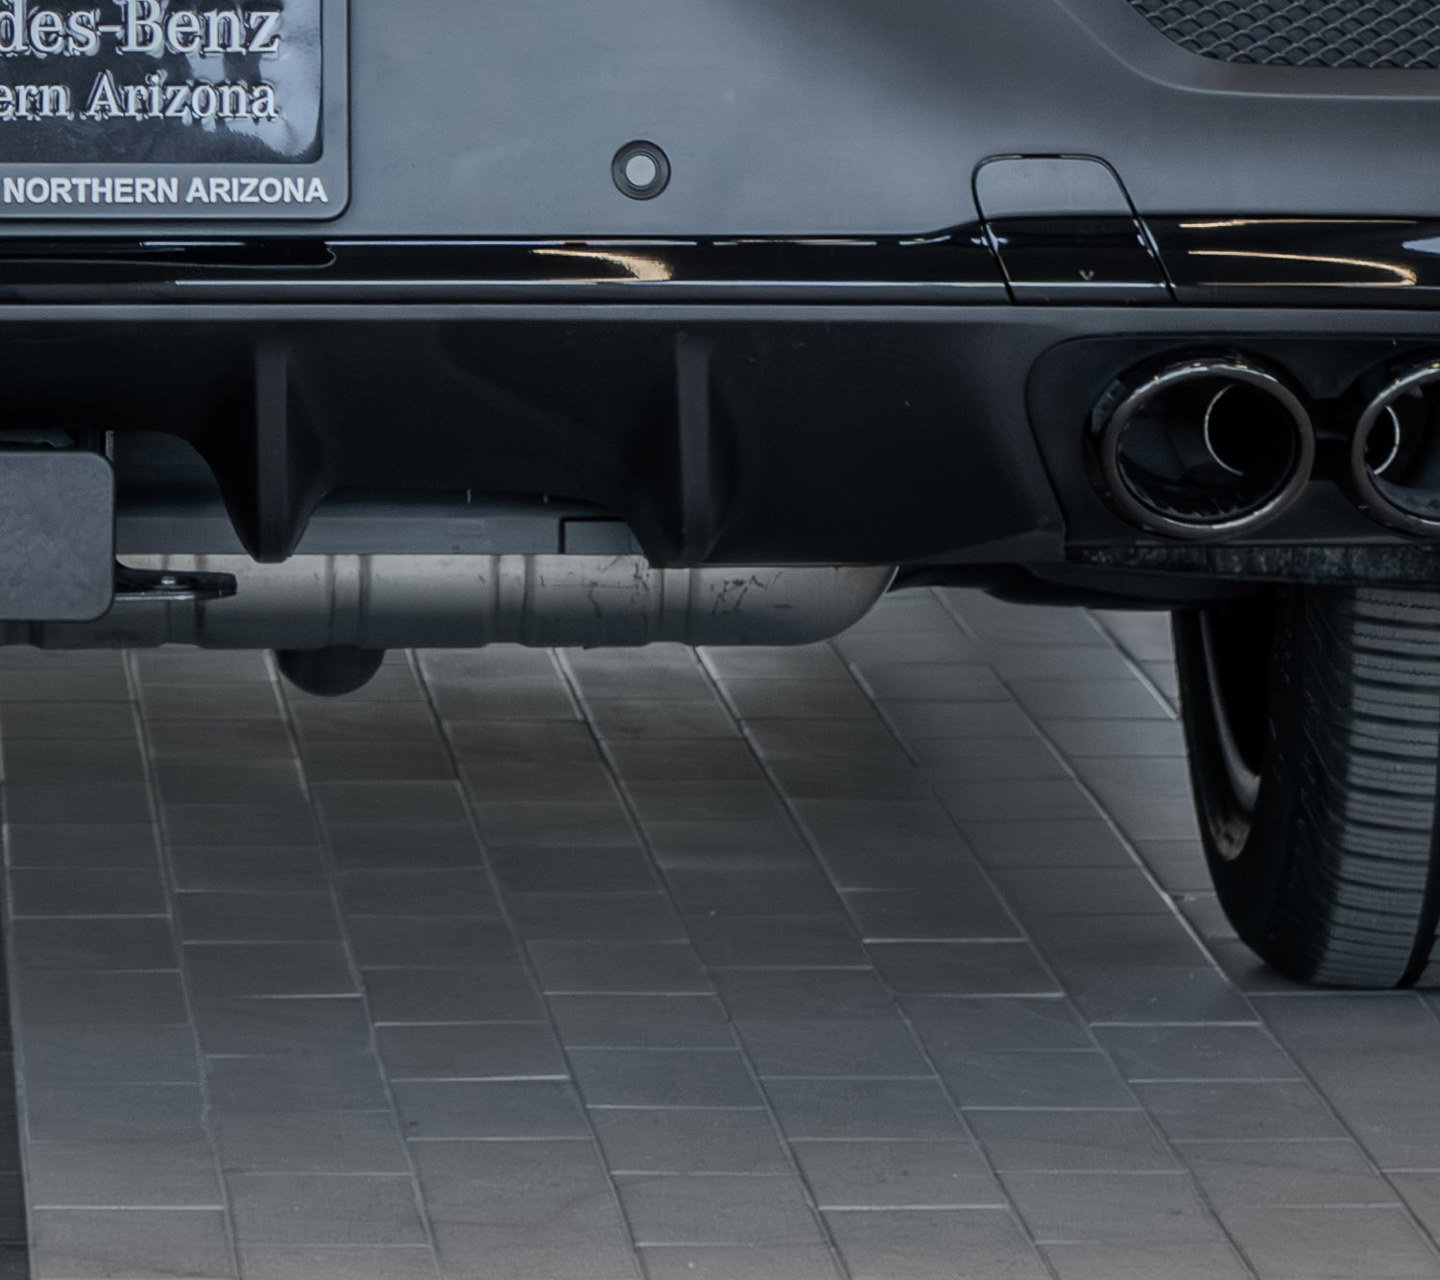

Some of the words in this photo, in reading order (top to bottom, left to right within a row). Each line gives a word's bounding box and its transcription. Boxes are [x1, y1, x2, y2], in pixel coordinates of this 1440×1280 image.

[86, 70, 278, 120] Arizona
[3, 176, 180, 204] NORTHERN
[185, 176, 329, 204] ARIZONA
